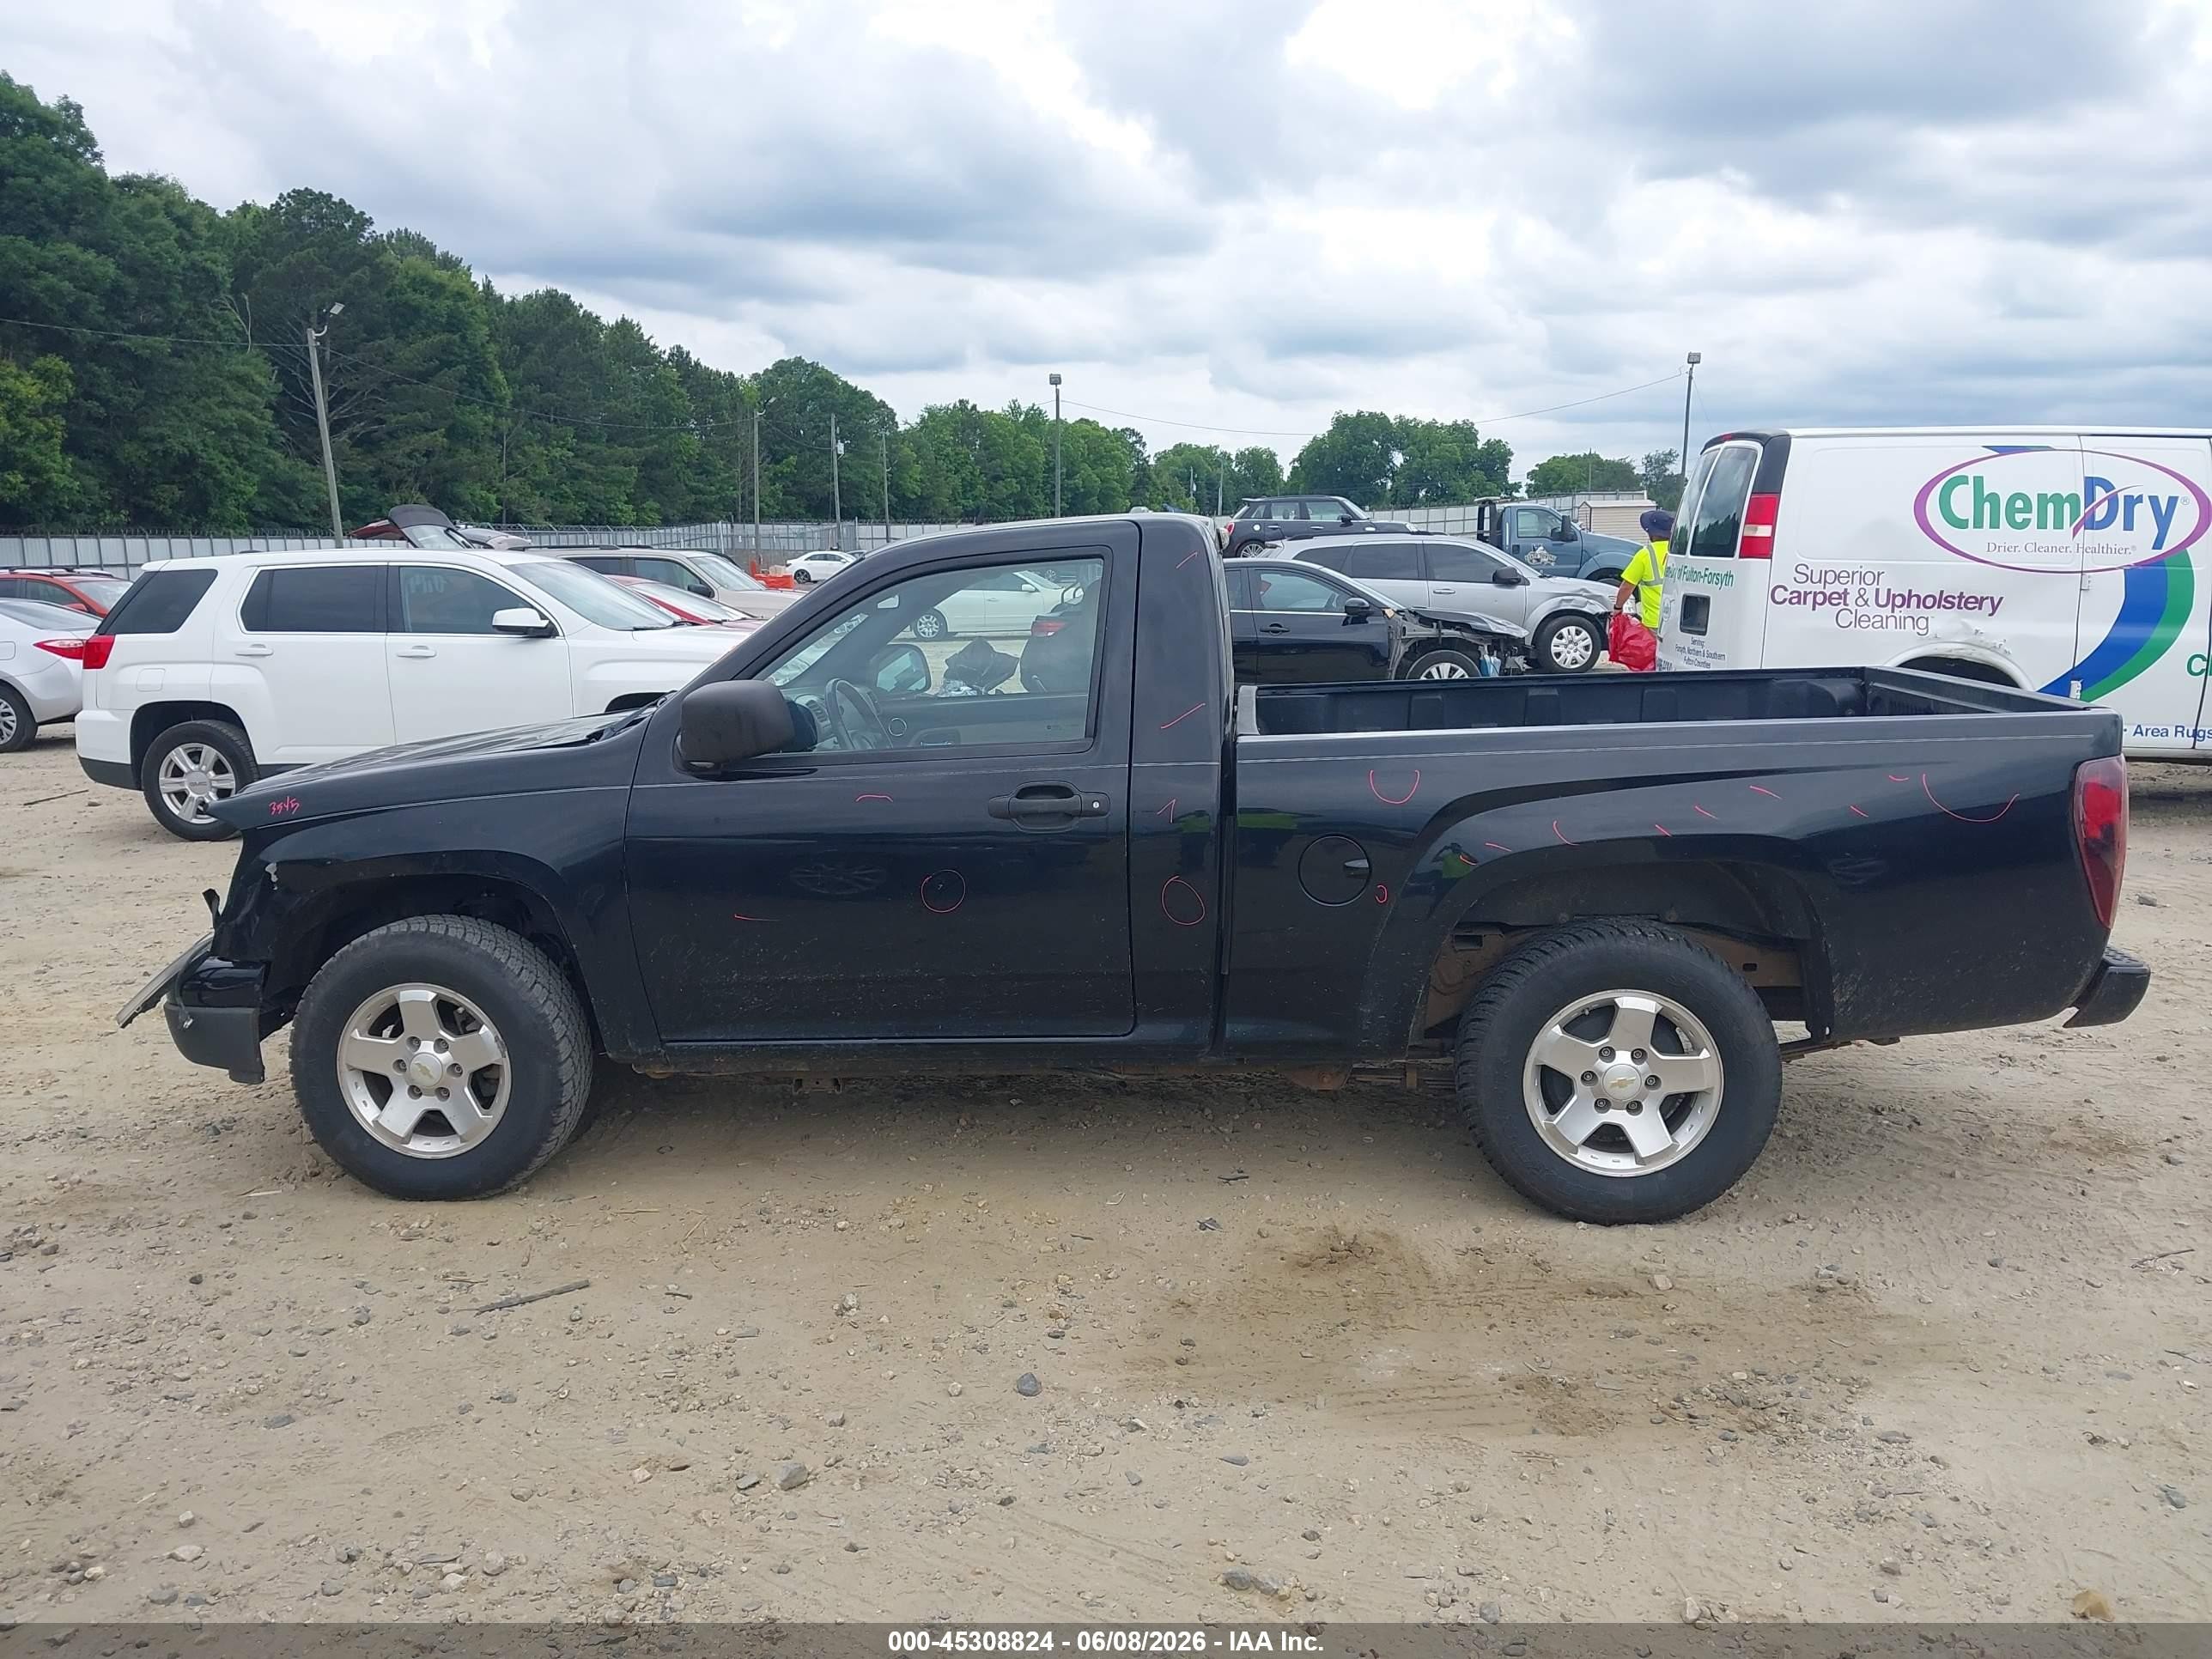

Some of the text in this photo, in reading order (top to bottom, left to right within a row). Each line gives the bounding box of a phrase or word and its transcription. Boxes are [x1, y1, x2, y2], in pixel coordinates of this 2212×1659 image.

[1986, 542, 2021, 554] Drier.
[2024, 542, 2073, 554] Cleaner.
[1683, 564, 1735, 590] Fulton-Forsyth
[1793, 563, 1885, 589] Superior
[1770, 585, 2004, 617] Carpet & Upholstery
[1835, 608, 1929, 636] Cleaning
[1706, 650, 1726, 660] Southern
[2133, 724, 2169, 738] Area
